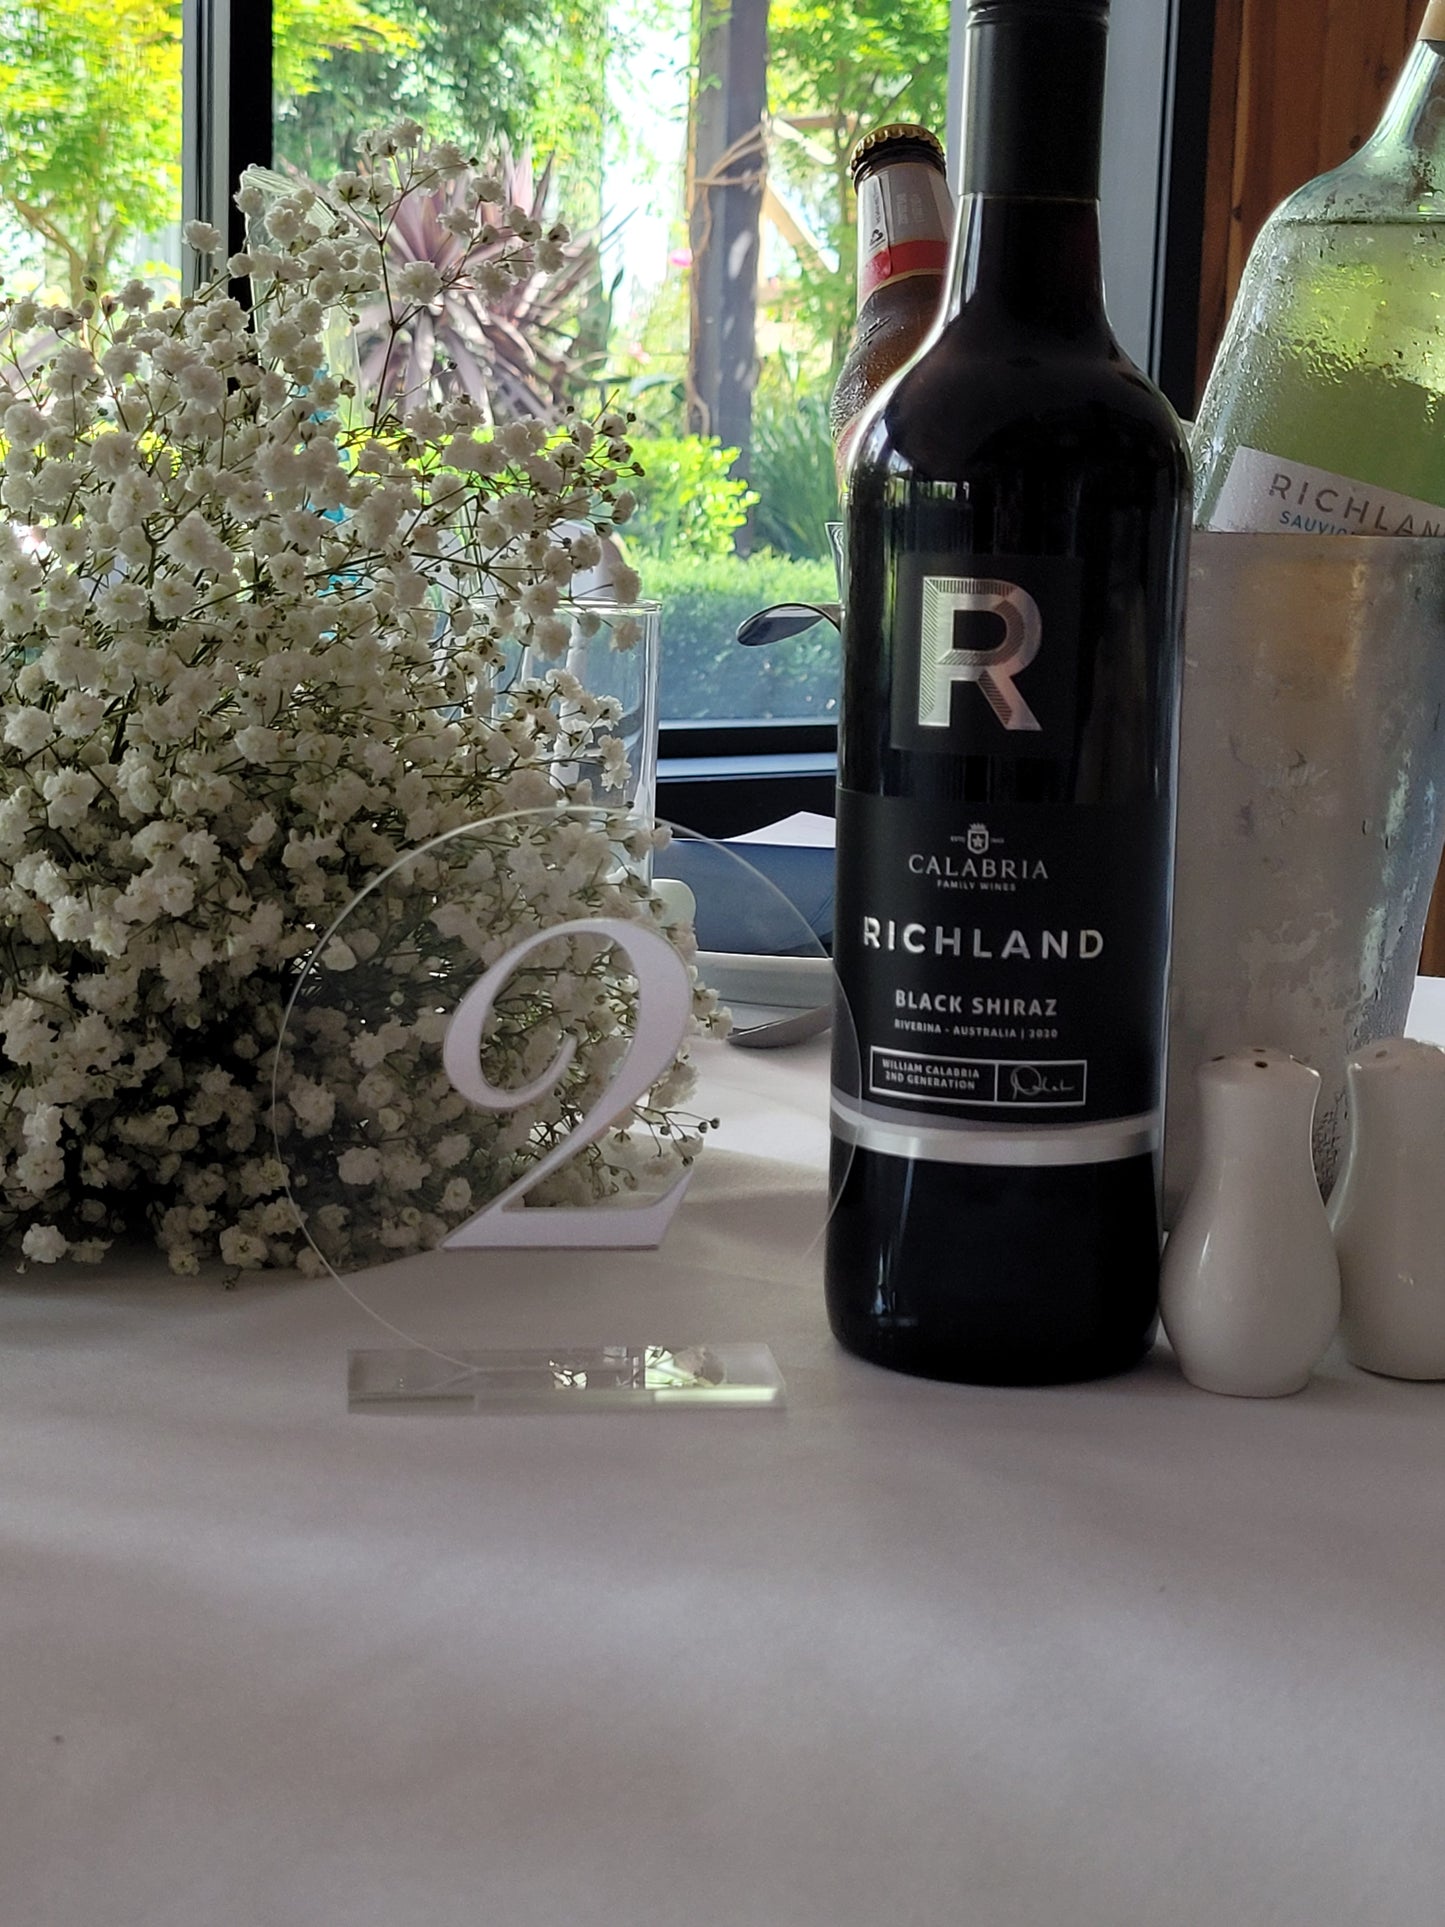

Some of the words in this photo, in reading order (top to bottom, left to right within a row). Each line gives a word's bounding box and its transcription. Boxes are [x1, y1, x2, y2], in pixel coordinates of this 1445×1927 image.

[918, 576, 1043, 731] R
[908, 854, 1049, 879] CALABRIA
[937, 879, 975, 890] FAMILY
[980, 881, 1016, 892] WINES
[863, 916, 1104, 959] RICHLAND
[895, 989, 962, 1013] BLACK
[971, 997, 1058, 1017] SHIRAZ
[894, 1018, 942, 1034] RIVERINA
[953, 1025, 1017, 1039] AUSTRALIA
[882, 1058, 923, 1073] WILLIAM
[925, 1065, 980, 1079] CALABRIA
[885, 1070, 904, 1083] 2ND
[906, 1074, 976, 1090] GENERATION
[439, 917, 694, 1250] 2
